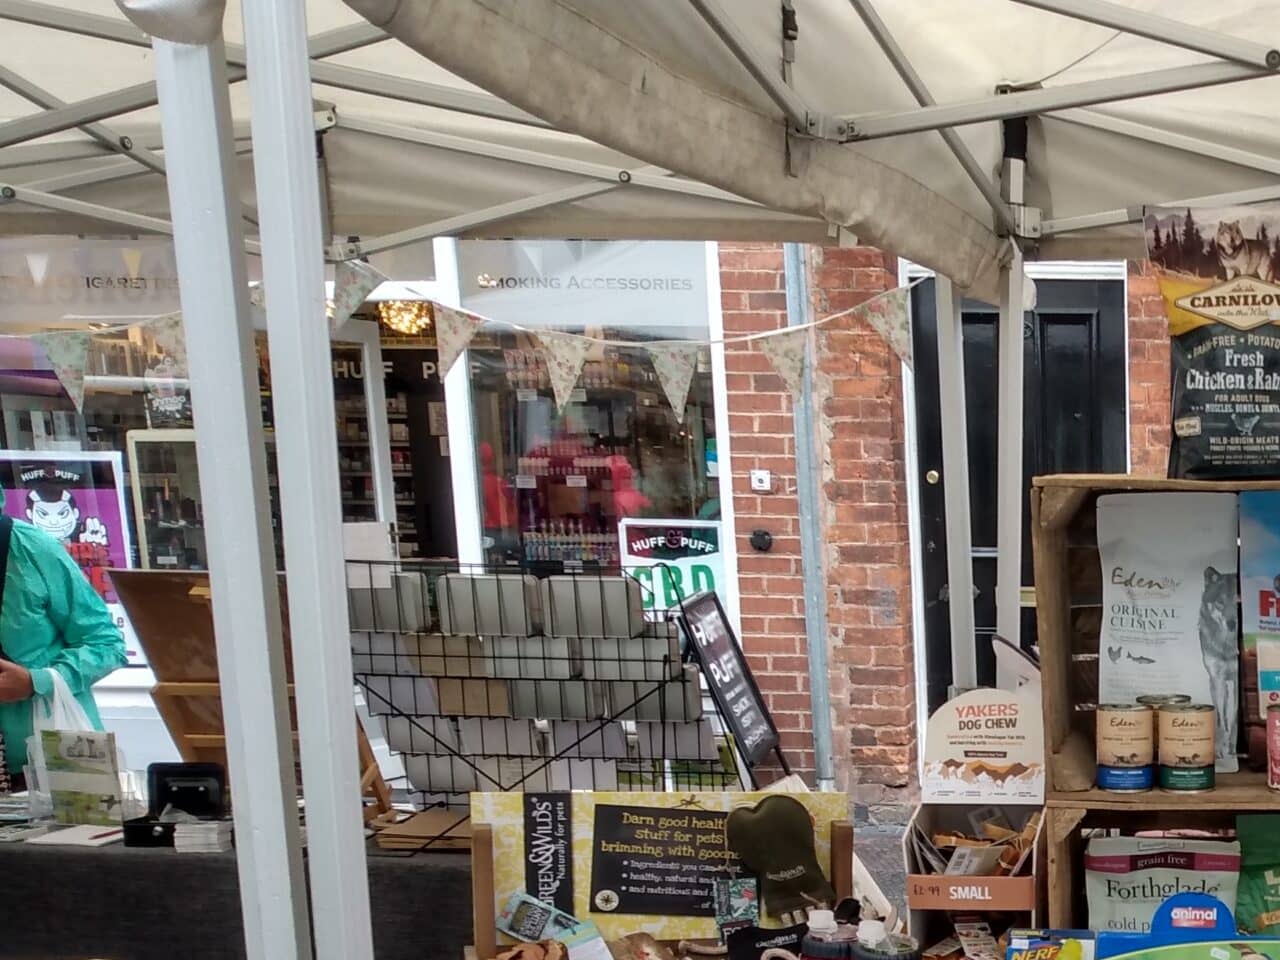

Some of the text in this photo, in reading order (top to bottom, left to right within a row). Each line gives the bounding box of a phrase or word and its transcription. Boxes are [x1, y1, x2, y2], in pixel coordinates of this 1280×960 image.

[567, 274, 693, 291] ACCESSORIES
[1225, 348, 1265, 367] Fresh
[1186, 368, 1246, 391] Chicken
[20, 469, 81, 482] HUFF PUFF
[631, 534, 667, 553] HUFF
[681, 537, 716, 553] PUFF
[1111, 566, 1164, 589] Eden
[632, 564, 717, 610] CBD
[1111, 603, 1178, 619] ORIGINAL
[1110, 615, 1167, 631] CUISINE
[955, 703, 1019, 719] YAKERS
[958, 718, 1018, 731] DOG CHEW
[622, 812, 727, 830] Darn good healt
[554, 801, 569, 880] Naturally for pets
[634, 828, 724, 846] stuff for pets
[601, 840, 696, 859] brimming with
[1137, 853, 1188, 868] grain free
[949, 885, 993, 900] SMALL
[1170, 907, 1218, 921] animal
[1107, 917, 1137, 931] cold
